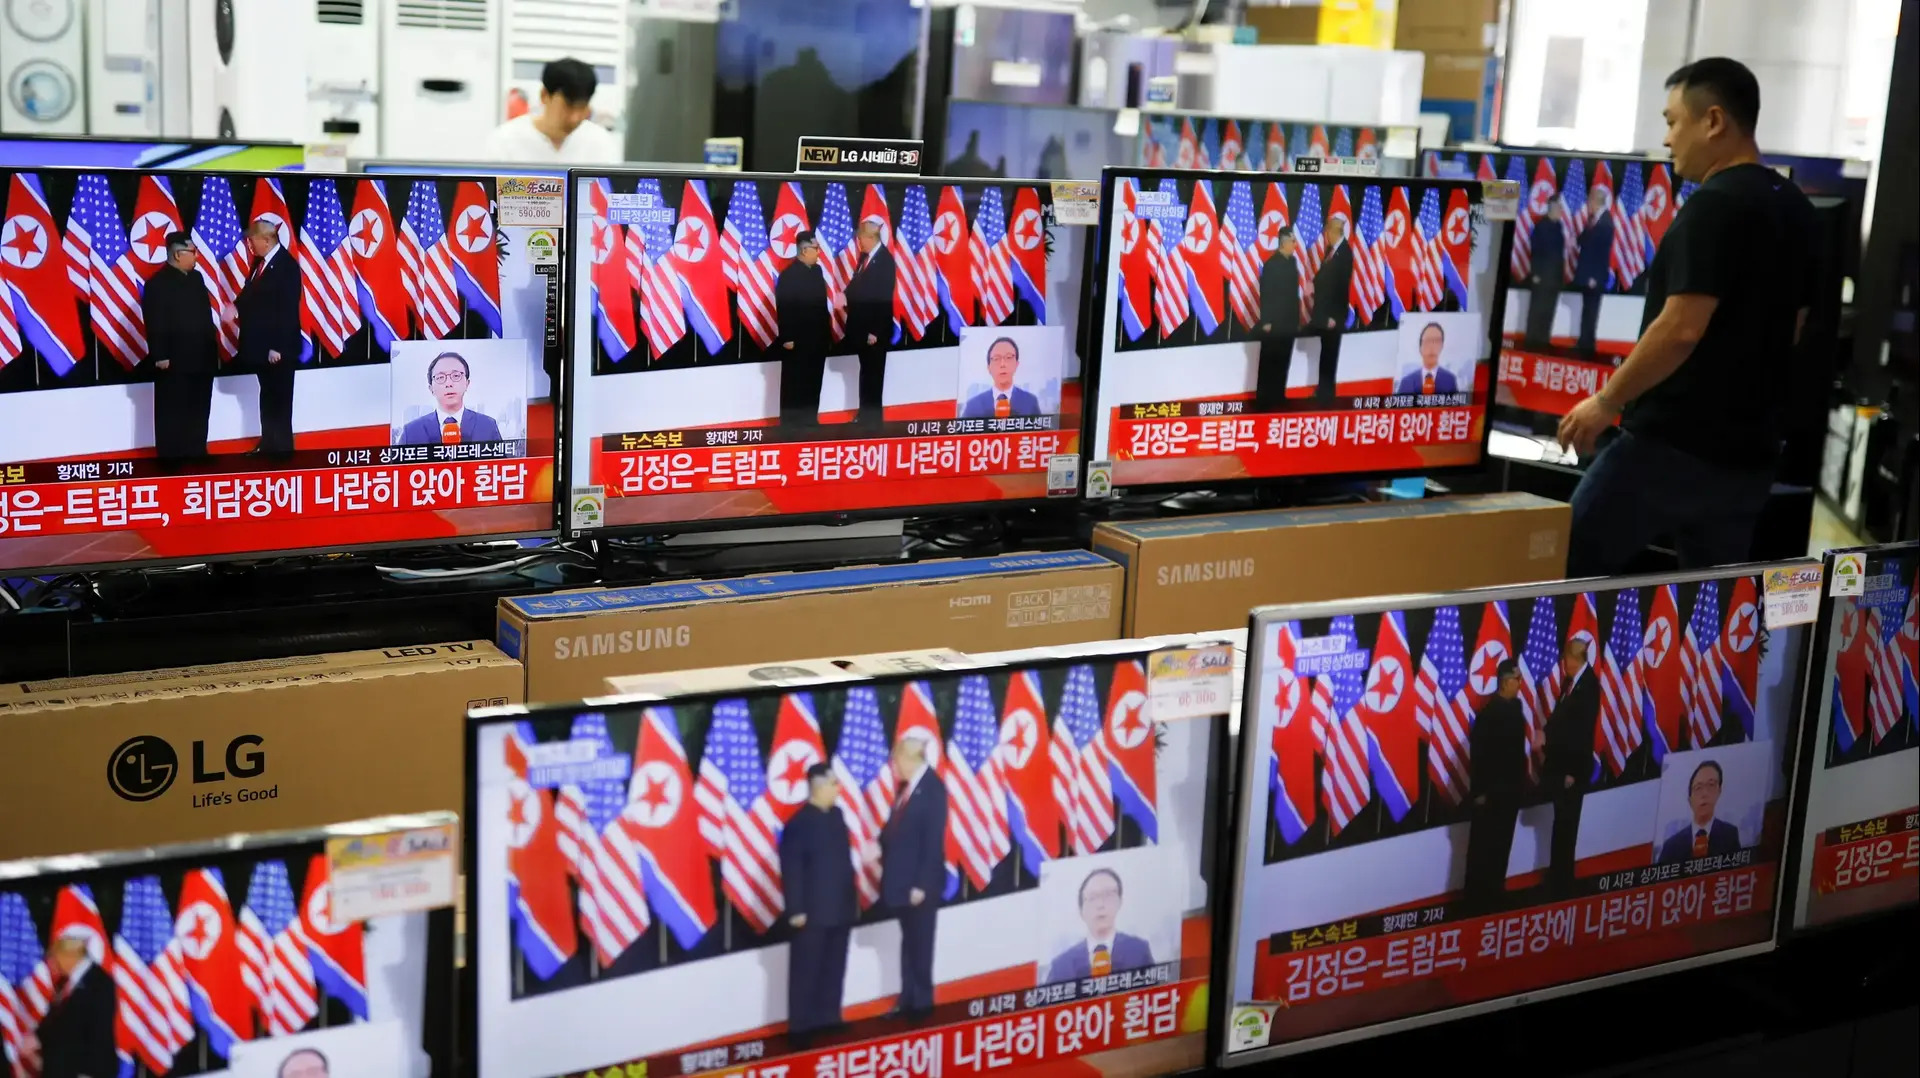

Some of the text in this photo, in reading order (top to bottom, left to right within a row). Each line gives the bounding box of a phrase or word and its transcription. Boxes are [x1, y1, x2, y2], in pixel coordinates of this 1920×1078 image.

[804, 149, 835, 161] NEW
[841, 150, 857, 162] LG
[610, 209, 672, 223] 미북정상회담
[1133, 402, 1181, 419] 뉴스속보
[1227, 401, 1243, 413] 기자
[705, 429, 763, 446] 황재헌 기자
[907, 416, 1052, 436] 이 시각 싱가포르 국제프레스센터
[1130, 410, 1472, 456] 김정은-트럼프, 회담장에 나란히 앉아 환담
[621, 431, 684, 450] 뉴스속보
[328, 442, 517, 466] 이 시각 싱가포르 국제프레스센터
[619, 434, 1060, 492] 김정은-트럼프, 회담장에 나란히 앉아 환담
[57, 462, 100, 481] 황재헌
[107, 461, 134, 476] 기자
[182, 474, 303, 520] 회담장에
[314, 469, 400, 513] 나란히
[409, 467, 465, 507] 앉아
[473, 462, 528, 502] 환담
[1156, 557, 1255, 586] SAMSUNG
[1799, 572, 1821, 584] SALE
[949, 594, 991, 608] HDMI
[1015, 593, 1044, 607] BACK
[382, 642, 474, 659] LED TV
[554, 625, 691, 660] SAMSUNG
[444, 657, 481, 667] 107
[192, 734, 265, 784] LG
[193, 784, 278, 808] Life's Good
[1839, 818, 1888, 843] 뉴스속보
[1599, 876, 1610, 891] 이
[1612, 872, 1635, 889] 시각
[1640, 863, 1680, 884] 싱가포르
[1286, 870, 1758, 1001] 김정은-트럼프, 회담장에 나란히 앉아 환담
[1290, 906, 1444, 952] 뉴스속보 황재헌 기자
[968, 1001, 984, 1017] 이
[989, 993, 1016, 1014] 시각
[1024, 982, 1076, 1008] 싱가포르
[954, 1013, 1045, 1072] 나란히
[1054, 1000, 1115, 1052] 앉아
[1122, 988, 1181, 1040] 환담
